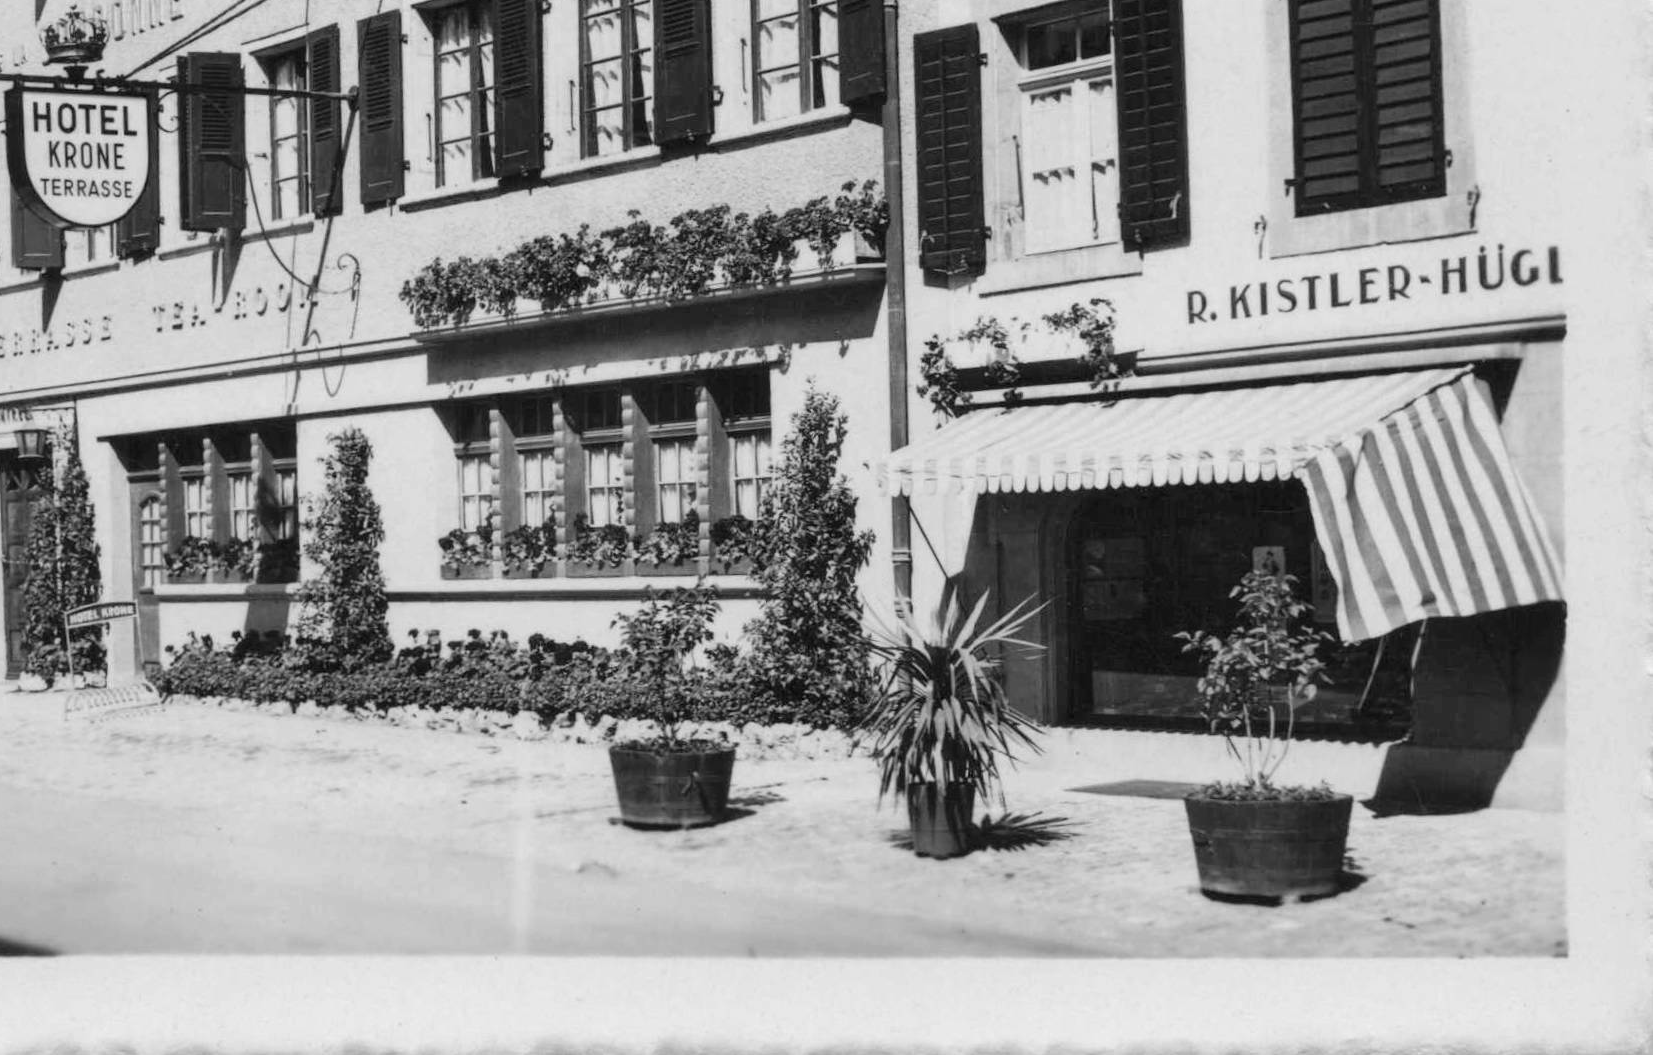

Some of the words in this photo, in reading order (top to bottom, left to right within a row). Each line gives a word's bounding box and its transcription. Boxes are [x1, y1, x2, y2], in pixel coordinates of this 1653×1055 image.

[32, 100, 138, 137] HOTEL
[48, 140, 126, 170] KRONE
[40, 177, 133, 199] TERRASSE
[1186, 289, 1218, 325] R.
[101, 605, 134, 618] KRONE
